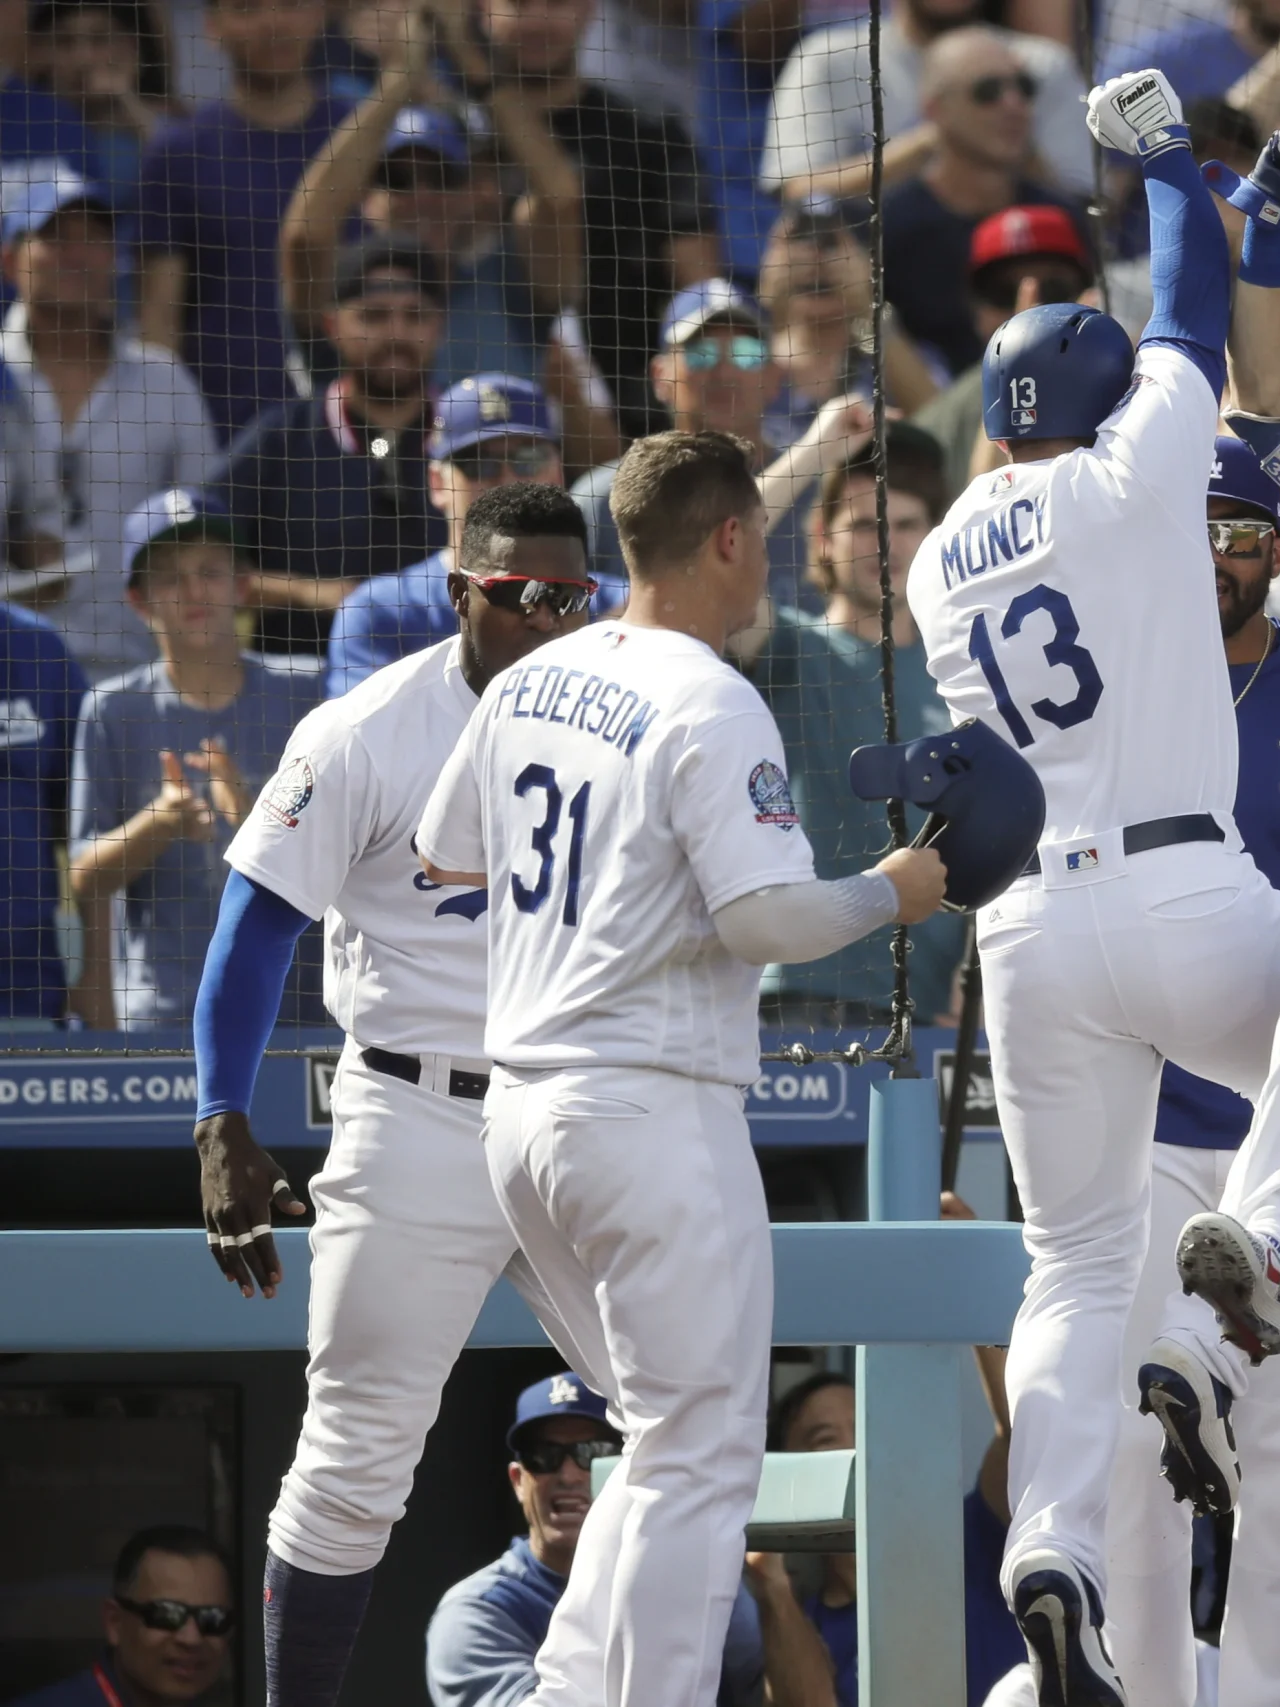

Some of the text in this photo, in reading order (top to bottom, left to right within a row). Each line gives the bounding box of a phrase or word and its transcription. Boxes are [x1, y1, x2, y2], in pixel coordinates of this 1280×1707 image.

[1117, 80, 1156, 113] Franklin
[1010, 377, 1036, 408] 13
[941, 490, 1049, 591] MUNCY
[494, 665, 660, 757] PEDERSON
[968, 584, 1104, 749] 13
[511, 763, 591, 927] 31
